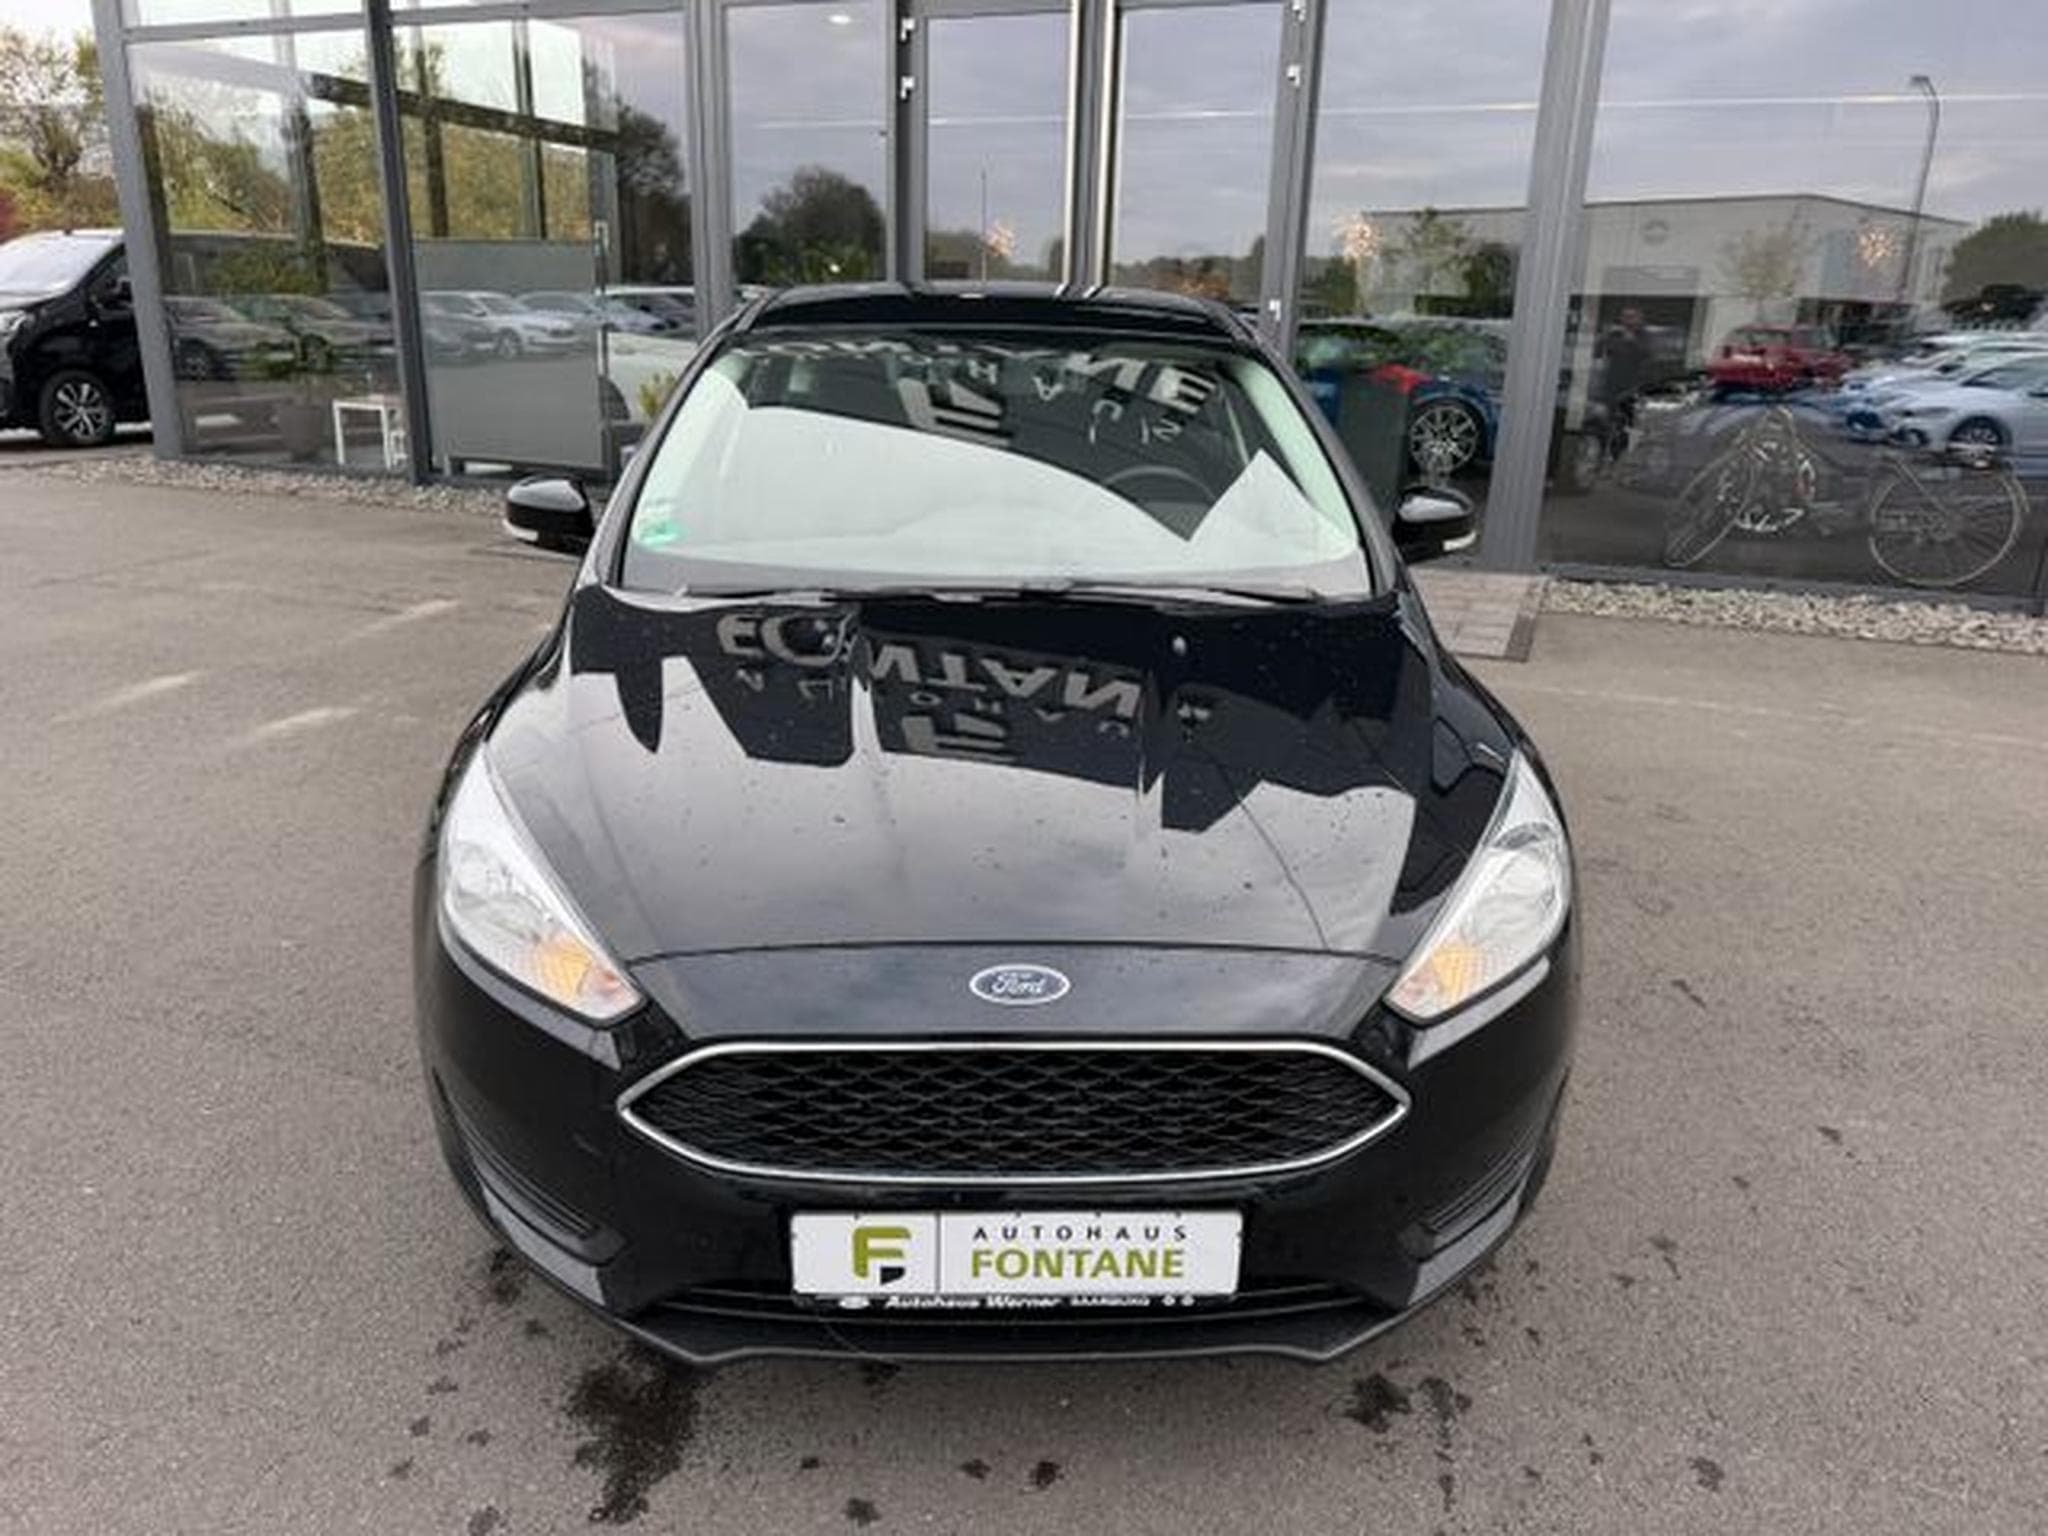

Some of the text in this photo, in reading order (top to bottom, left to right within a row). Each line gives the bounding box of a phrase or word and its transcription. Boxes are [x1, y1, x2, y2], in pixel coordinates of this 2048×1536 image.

[991, 971, 1047, 995] Ford
[973, 1226, 1187, 1241] AUTOHAUS
[971, 1249, 1185, 1279] FONTANE
